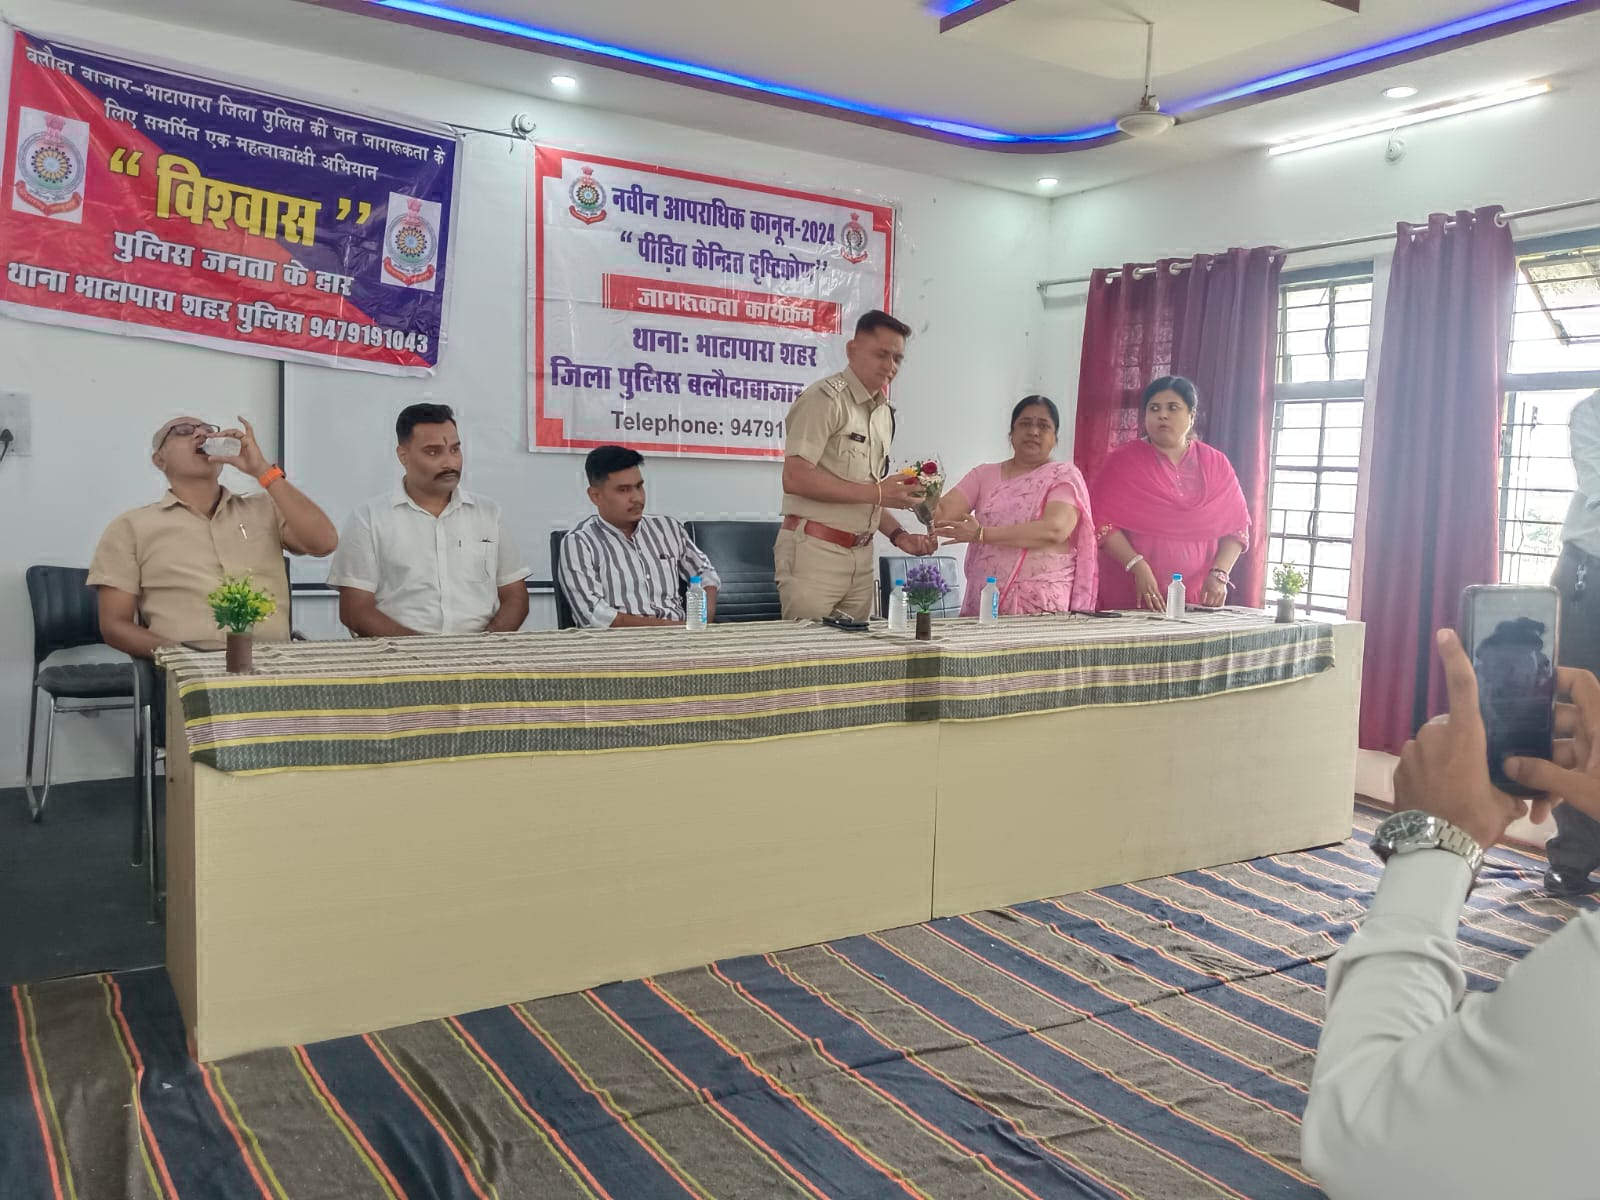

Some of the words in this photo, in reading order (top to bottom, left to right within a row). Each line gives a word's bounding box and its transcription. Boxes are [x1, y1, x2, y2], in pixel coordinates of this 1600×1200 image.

[104, 98, 138, 128] लिए
[144, 114, 200, 141] समर्पित
[205, 130, 231, 149] एक
[235, 135, 317, 167] महत्वाकांक्षी
[322, 152, 378, 180] अभियान
[218, 94, 257, 123] जिला
[263, 107, 304, 133] पुलिस
[310, 117, 328, 139] की
[333, 127, 358, 146] जन
[433, 145, 446, 166] के
[157, 153, 322, 247] विश्वास
[611, 183, 659, 217] नवीन
[663, 198, 745, 230] आपराधिक
[750, 210, 835, 246] कानून-2024
[114, 230, 196, 267] पुलिस
[202, 249, 277, 282] जनता
[283, 259, 309, 286] के
[638, 231, 687, 273] पीड़ित
[7, 262, 70, 293] थाना
[74, 275, 177, 312] भाटापारा
[182, 294, 233, 322] शहर
[236, 301, 305, 334] पुलिस
[309, 317, 429, 353] 9479191043
[551, 355, 612, 389] जिला
[618, 362, 681, 400] पुलिस
[696, 334, 775, 363] भाटापारा
[780, 342, 817, 367] शहर
[611, 410, 723, 437] Telephone:
